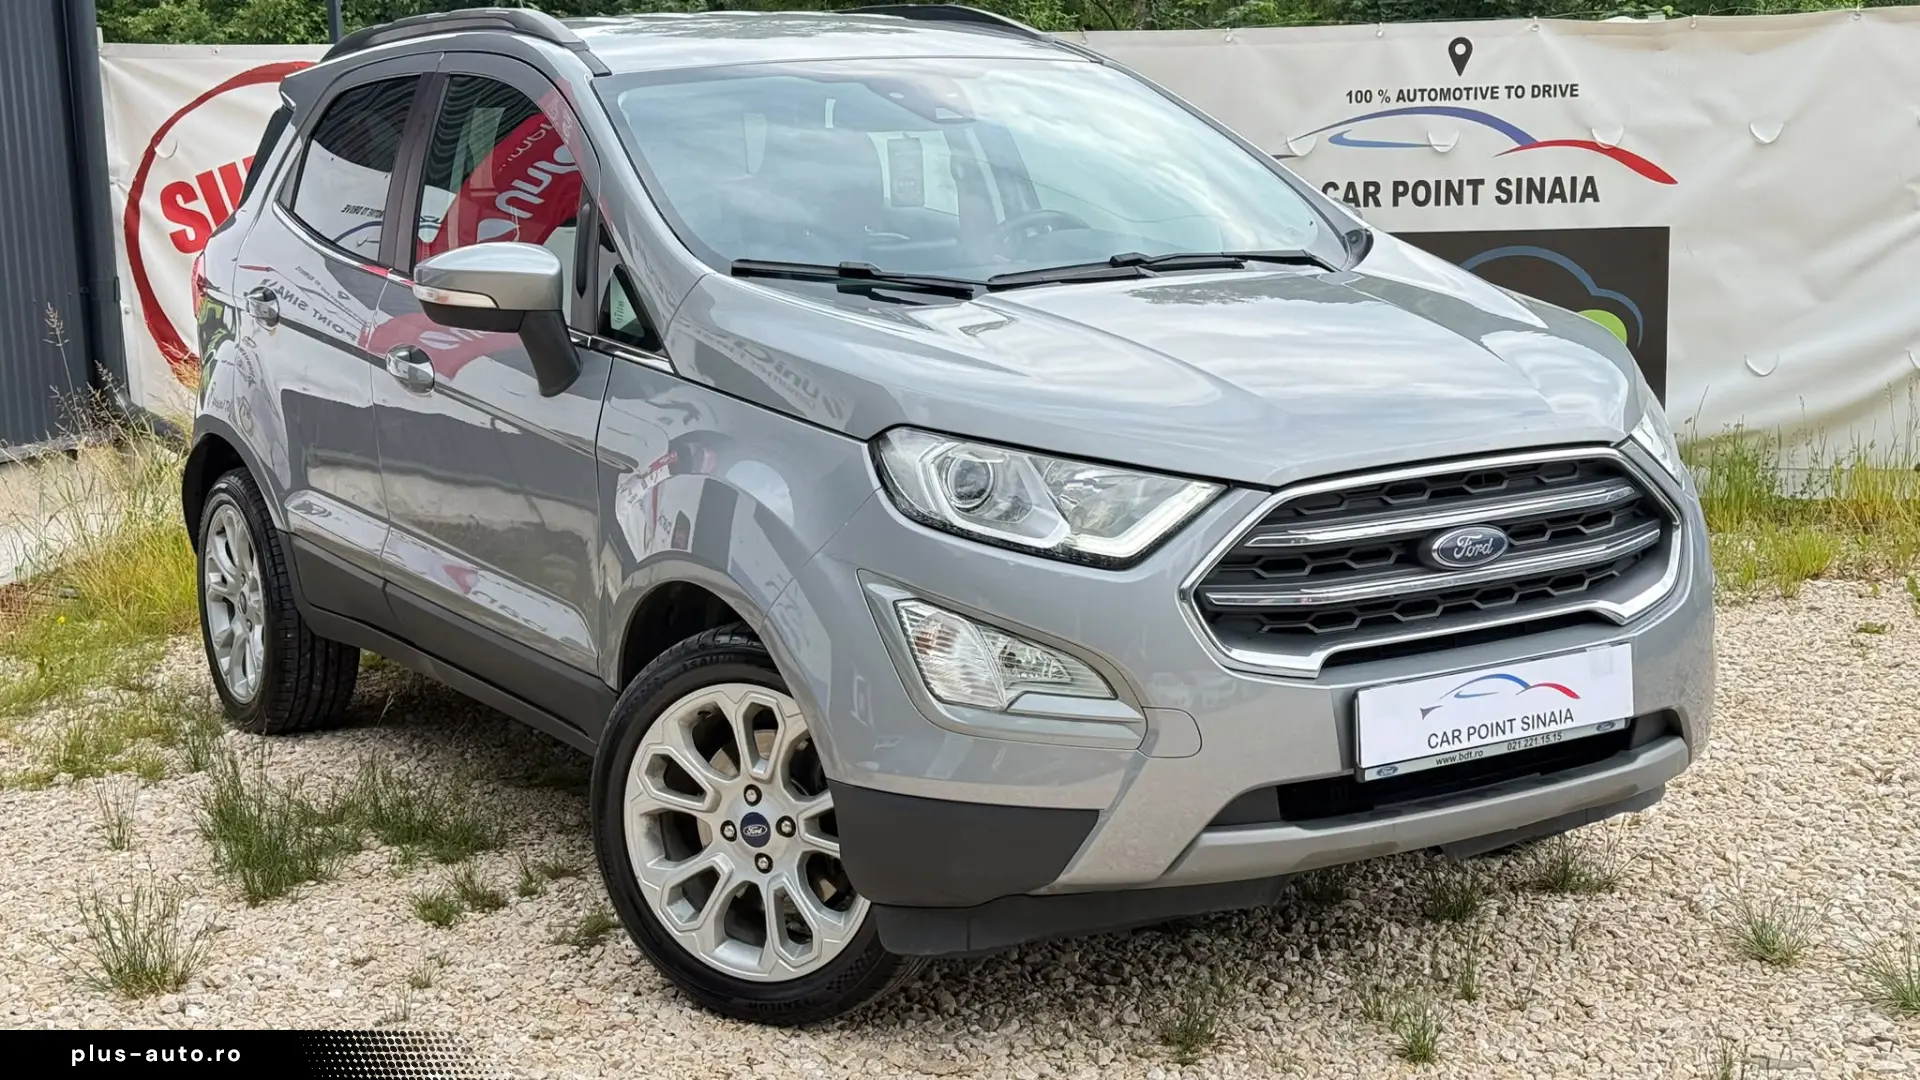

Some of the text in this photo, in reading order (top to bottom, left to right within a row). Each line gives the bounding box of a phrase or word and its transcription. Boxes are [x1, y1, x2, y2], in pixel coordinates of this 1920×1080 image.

[1346, 83, 1580, 104] 100 % AUTOMOTIVE TO DRIVE
[1321, 176, 1600, 208] CAR POINT SINAIA
[1453, 534, 1494, 559] Ford
[1427, 729, 1462, 749] CAR
[1467, 718, 1517, 742] POINT
[1521, 708, 1574, 732] SINAIA
[1435, 732, 1562, 766] www.bdt.ro 021.221.15.15
